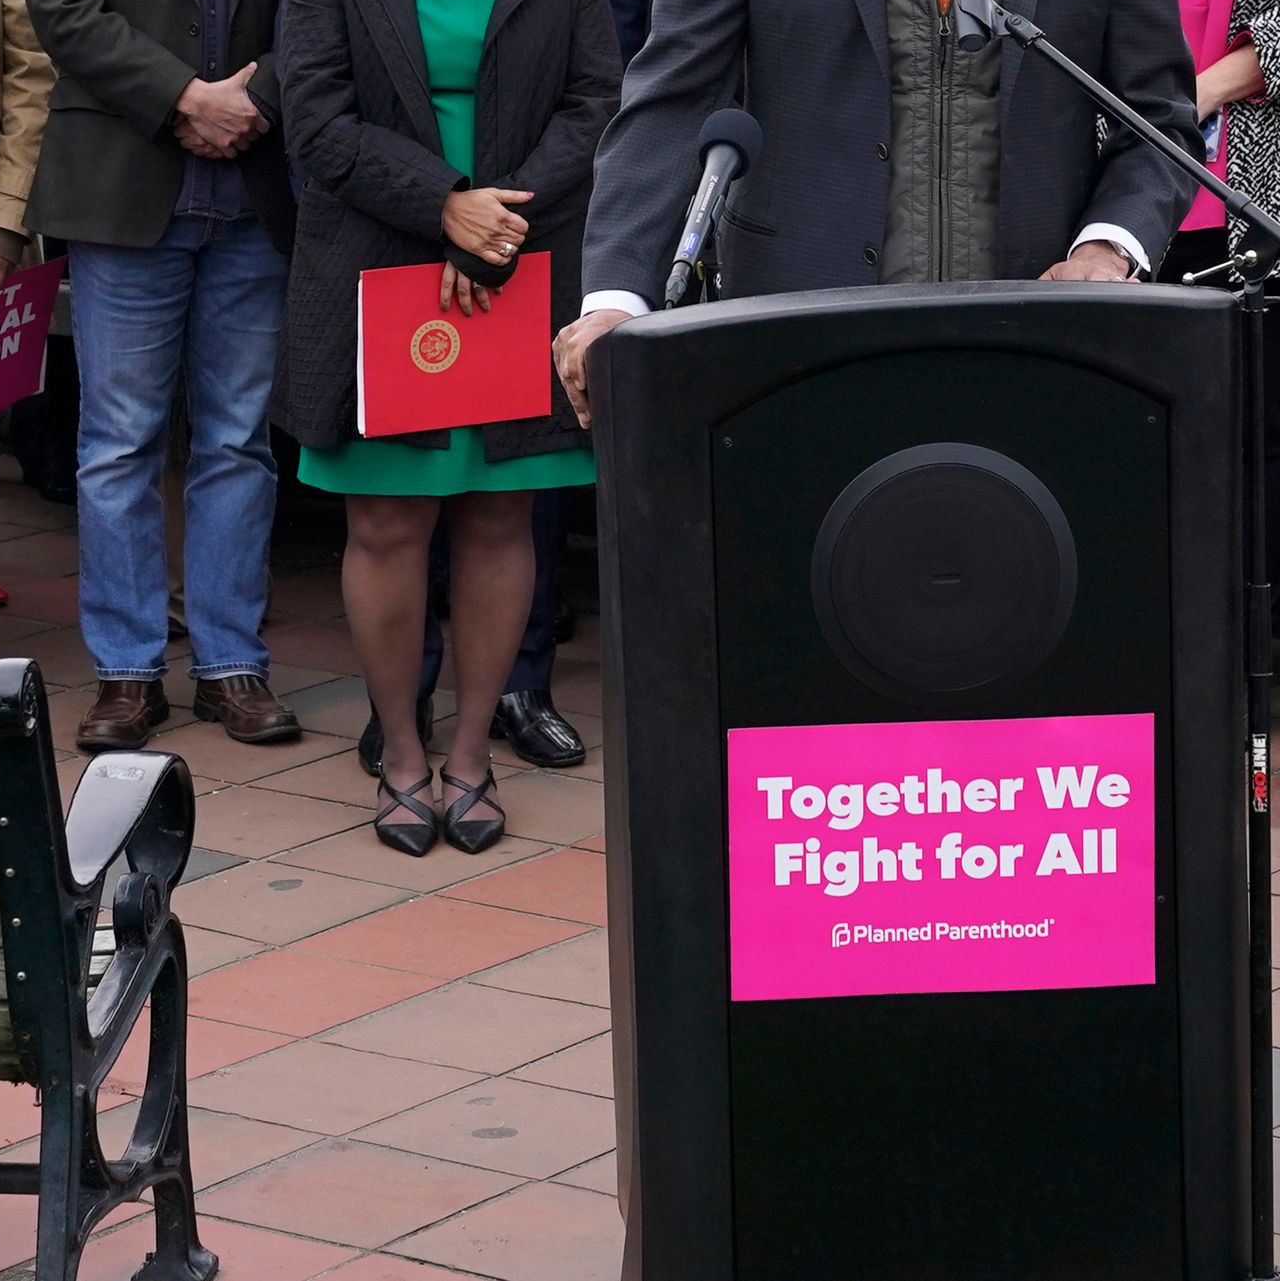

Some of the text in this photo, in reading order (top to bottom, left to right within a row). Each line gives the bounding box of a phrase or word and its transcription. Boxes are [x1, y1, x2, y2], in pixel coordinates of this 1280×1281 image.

[756, 764, 1131, 831] Together We
[774, 827, 1118, 897] Fight for All
[853, 918, 1051, 944] Planned Parenthood
